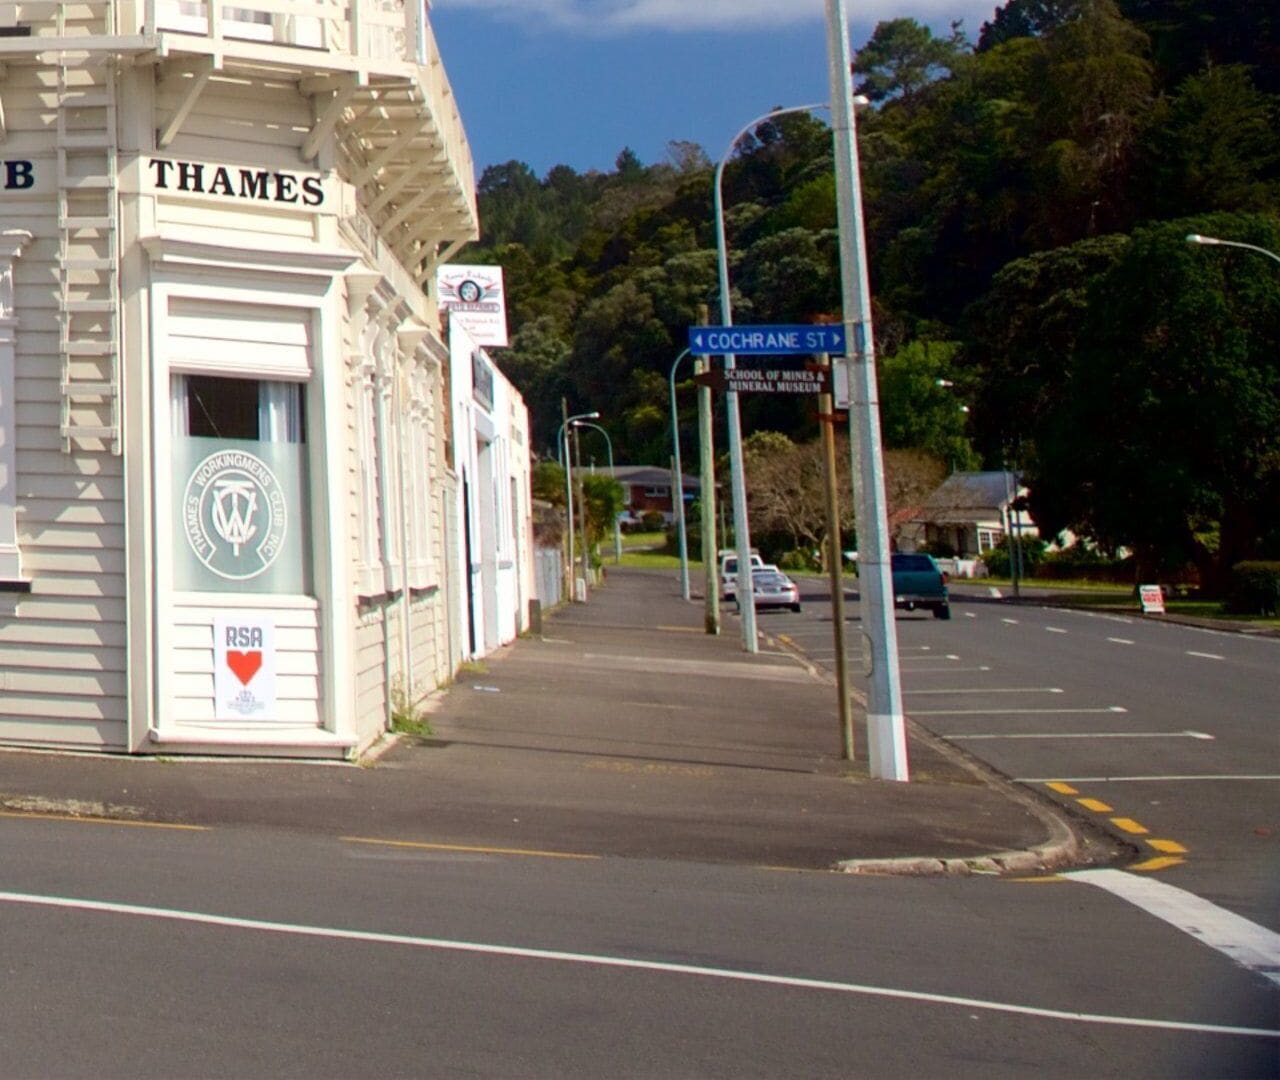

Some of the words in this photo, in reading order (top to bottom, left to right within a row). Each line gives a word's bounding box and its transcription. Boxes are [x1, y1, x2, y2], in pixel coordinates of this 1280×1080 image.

[148, 158, 325, 207] THAMES
[708, 332, 801, 350] COCHRANE
[806, 332, 826, 348] ST
[724, 370, 764, 381] SCHOOL
[766, 371, 779, 381] OF
[782, 371, 814, 382] MINES
[816, 372, 825, 382] &
[729, 381, 775, 392] MINERAL
[777, 382, 821, 393] MUSEUM
[194, 453, 273, 488] WORKINGMENS
[269, 490, 283, 527] CLUB
[187, 495, 207, 554] THAMES
[226, 626, 263, 648] RSA
